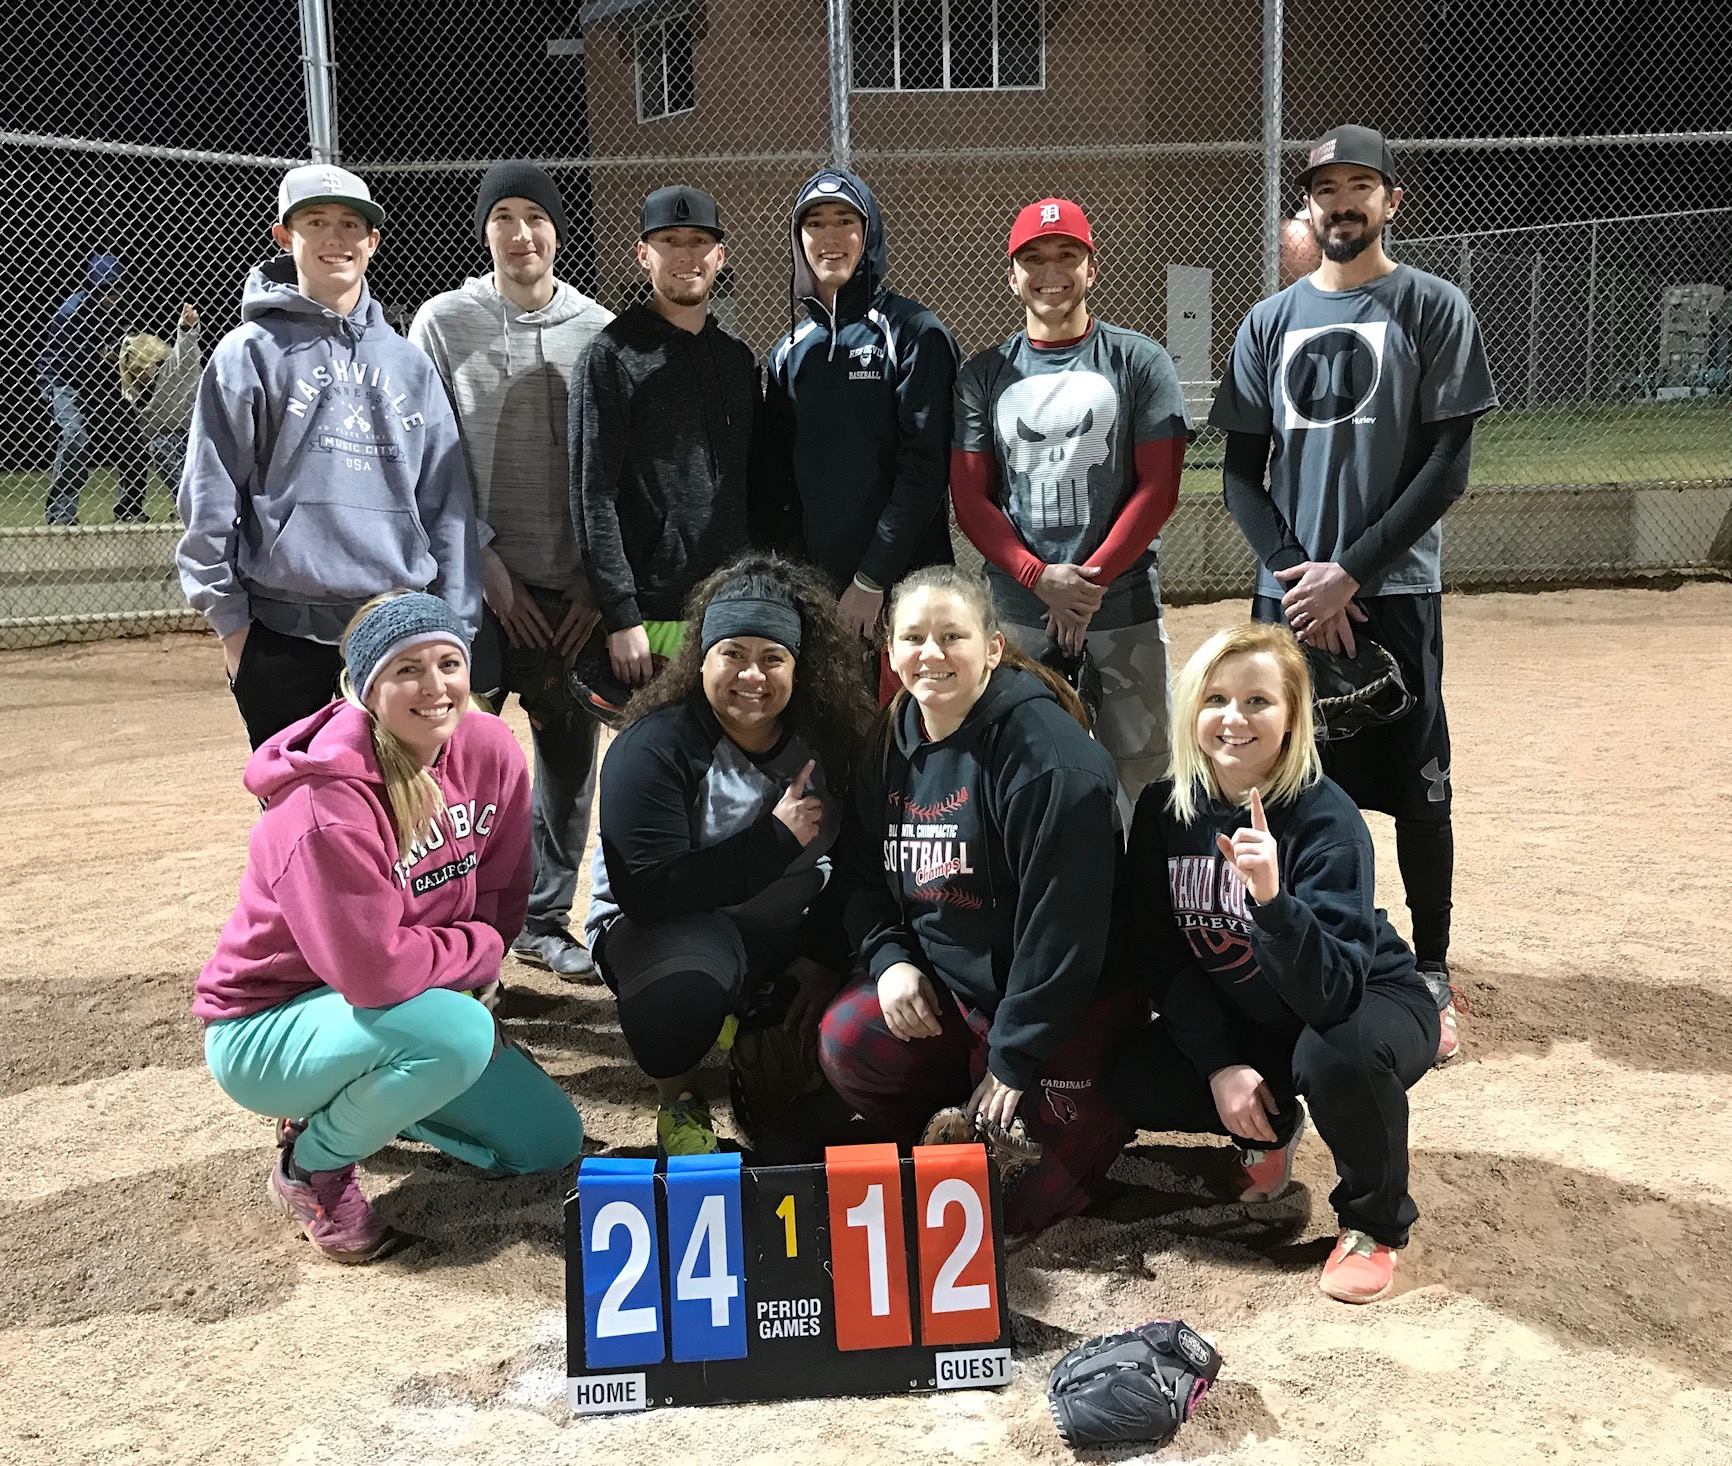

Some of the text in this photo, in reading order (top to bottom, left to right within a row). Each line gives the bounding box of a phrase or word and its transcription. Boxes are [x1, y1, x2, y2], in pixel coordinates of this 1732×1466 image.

[1039, 204, 1061, 228] D
[848, 370, 881, 380] BASEBALL
[286, 359, 425, 432] NASHVILLE
[1351, 416, 1377, 425] Hurley
[325, 437, 395, 456] MUSIC CITY
[346, 458, 372, 472] USA
[883, 840, 974, 875] SOFTBALL
[915, 857, 961, 887] Champs
[1040, 1078, 1092, 1090] CARDINALS
[775, 1194, 799, 1259] 1
[756, 1298, 822, 1320] PERIOD
[758, 1317, 822, 1340] GAMES
[940, 1356, 1007, 1381] GUEST
[577, 1381, 637, 1406] HOME
